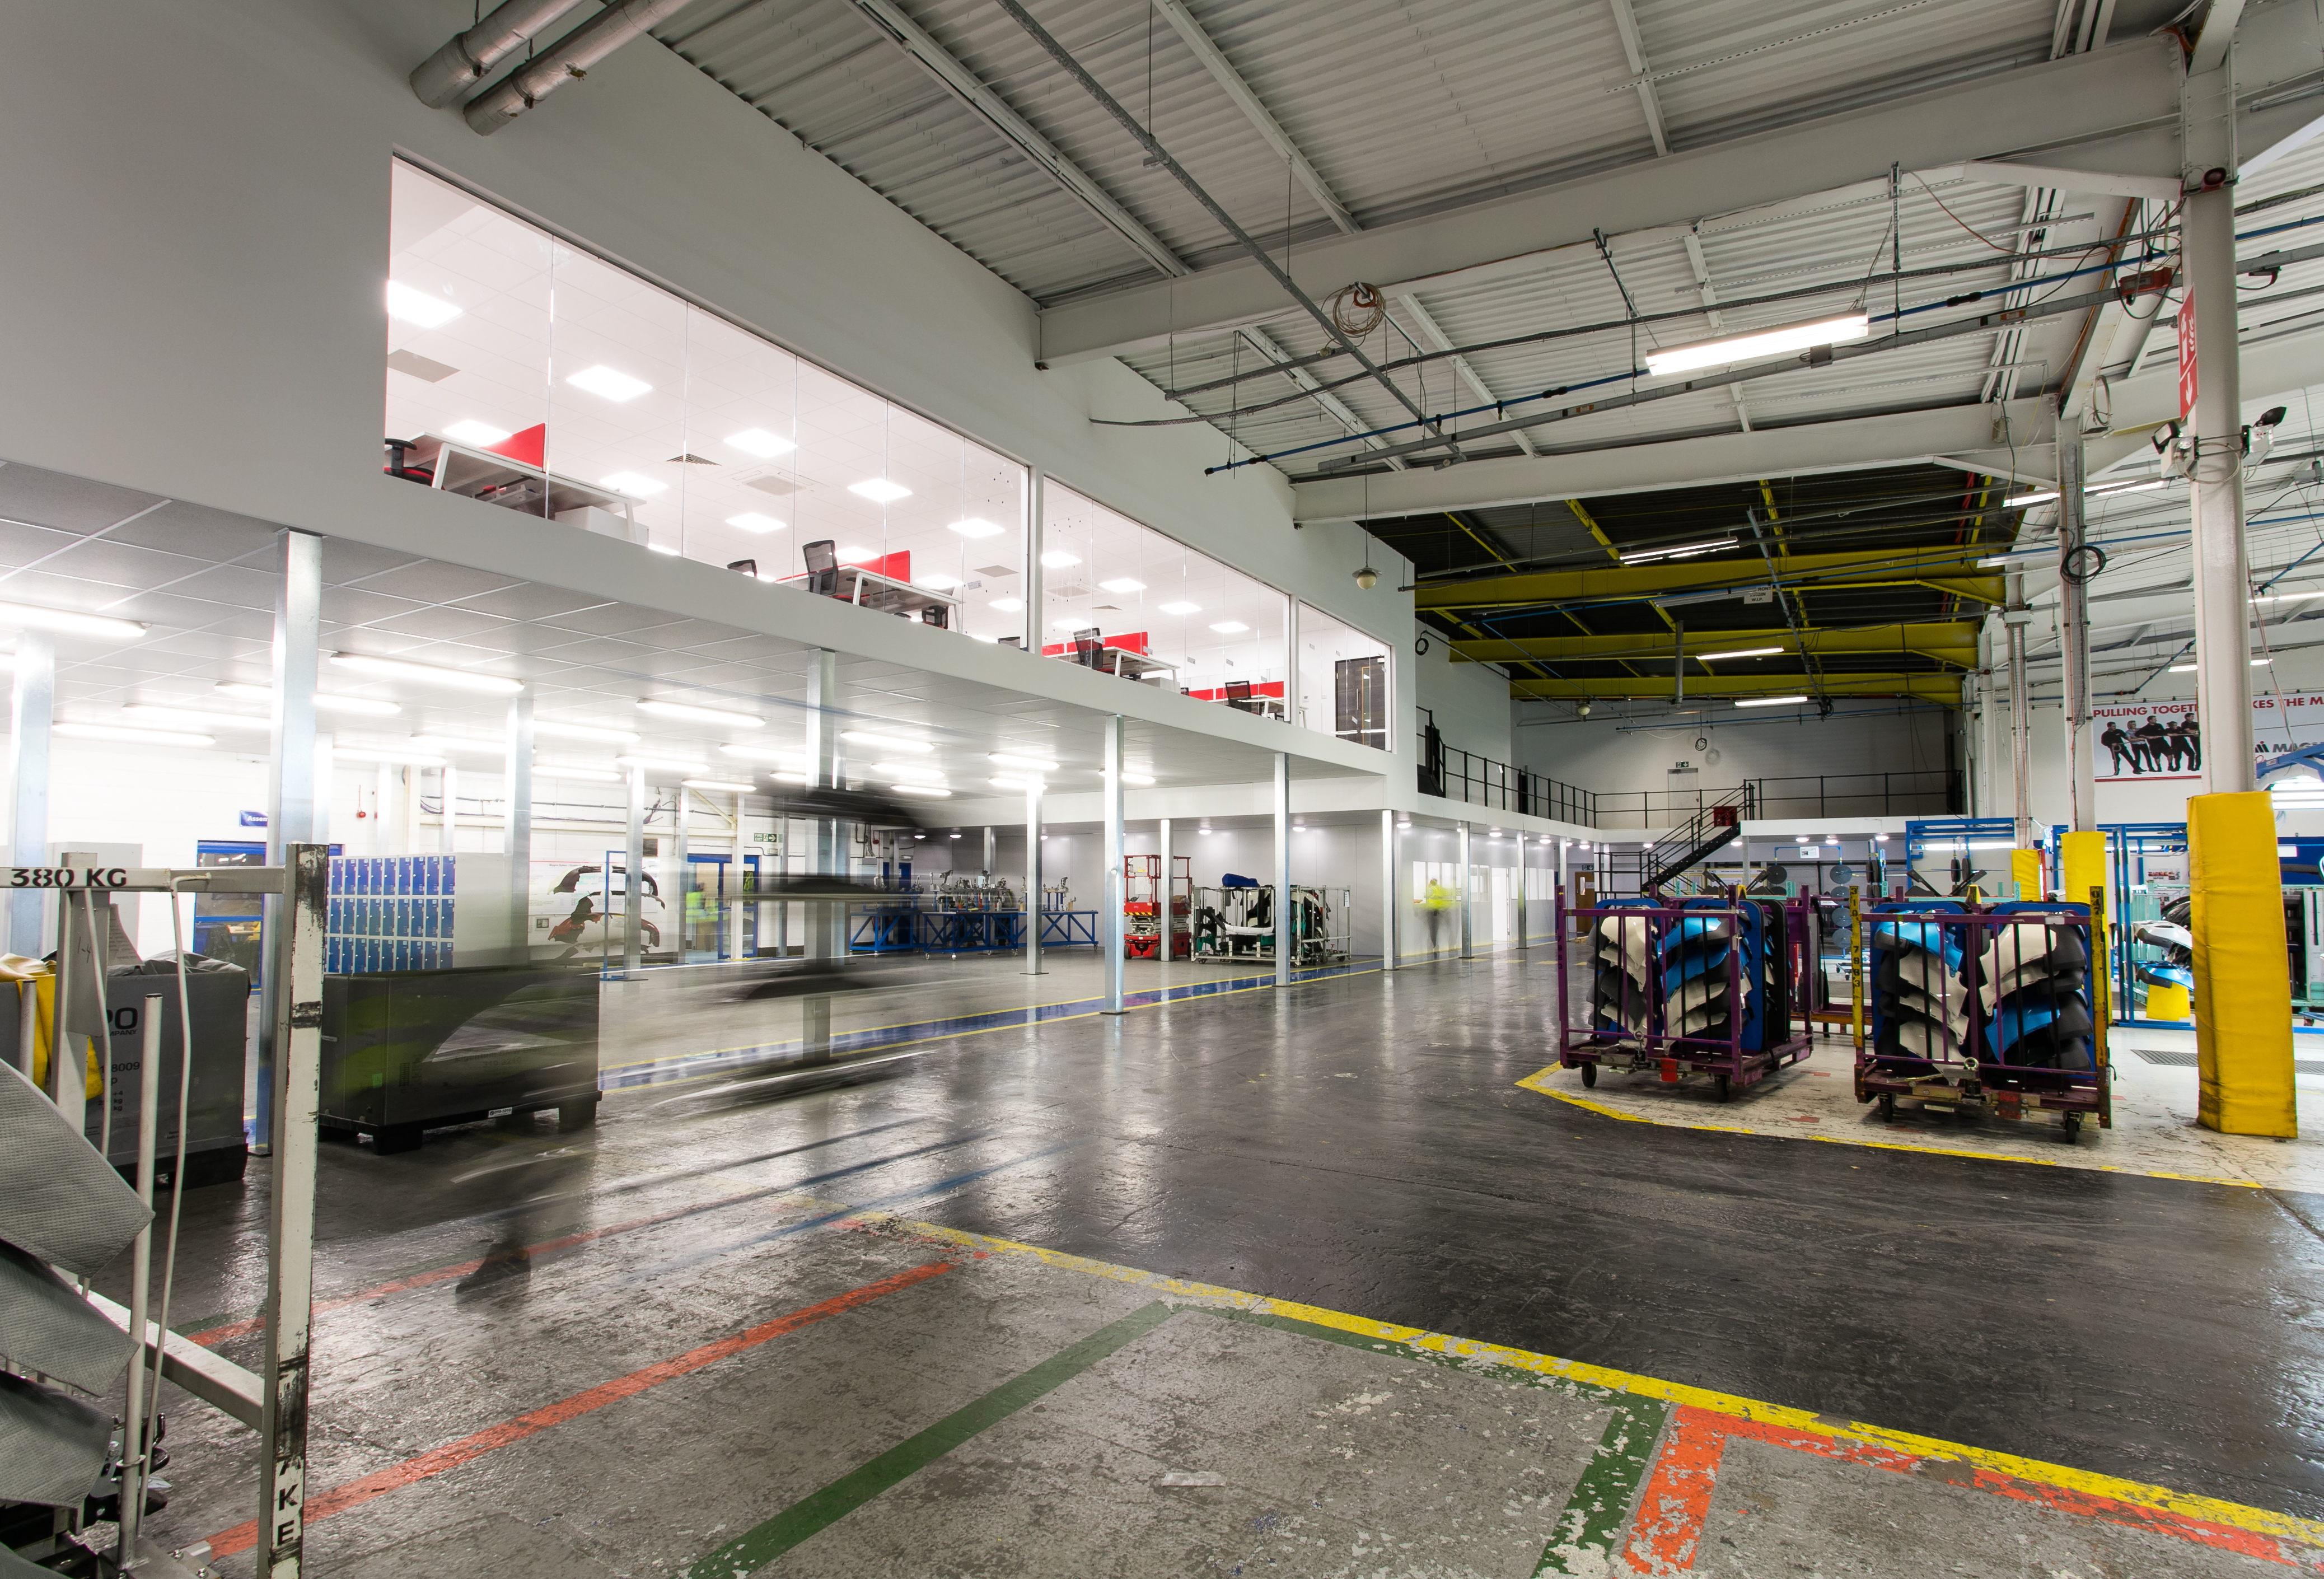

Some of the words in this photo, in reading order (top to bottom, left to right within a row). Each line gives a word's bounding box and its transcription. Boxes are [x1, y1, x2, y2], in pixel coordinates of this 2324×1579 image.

[2093, 707, 2147, 718] PULLING
[2152, 704, 2197, 714] TOGET
[2309, 696, 2324, 706] M
[11, 868, 74, 887] 380
[87, 868, 127, 887] KG
